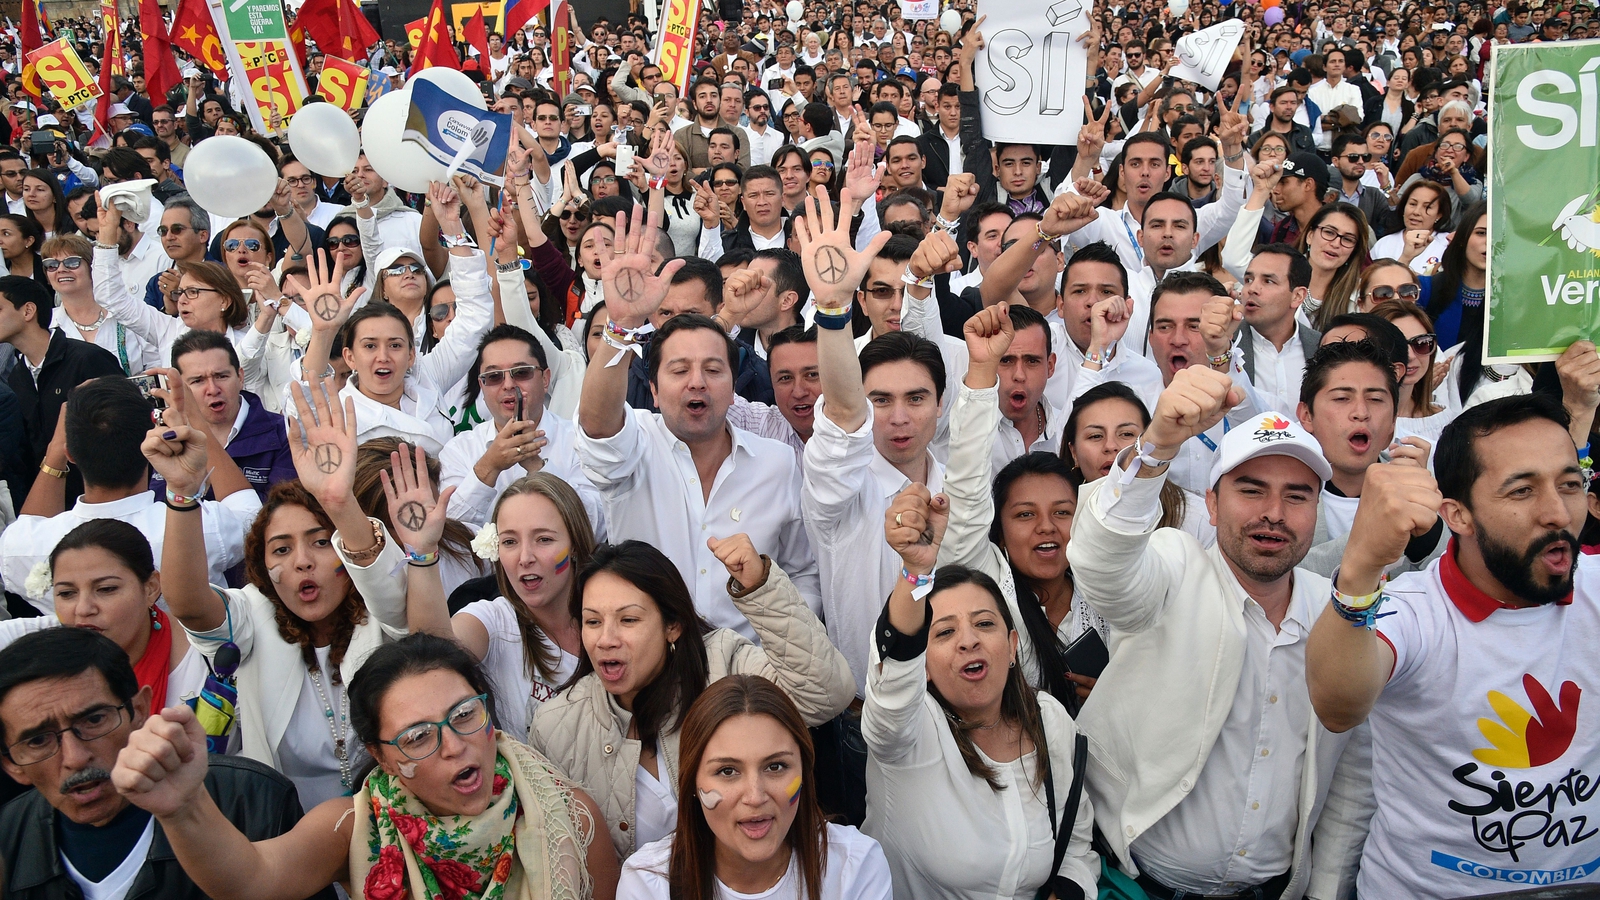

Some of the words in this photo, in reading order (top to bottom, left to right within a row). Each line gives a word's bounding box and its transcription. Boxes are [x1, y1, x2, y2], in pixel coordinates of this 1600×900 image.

[246, 5, 252, 13] Y
[251, 4, 280, 12] PAREMOS
[250, 18, 274, 26] GUERRA
[251, 25, 264, 34] YA!
[671, 23, 685, 36] PTC
[35, 38, 95, 100] SÍ
[658, 38, 690, 86] SÍ
[984, 0, 1082, 116] SÍ
[67, 89, 90, 105] PTC
[1516, 56, 1600, 150] SÍ
[1540, 273, 1600, 306] Ver
[531, 680, 561, 702] EX
[1448, 762, 1600, 816] Siente
[1456, 860, 1588, 885] COLOMBIA
